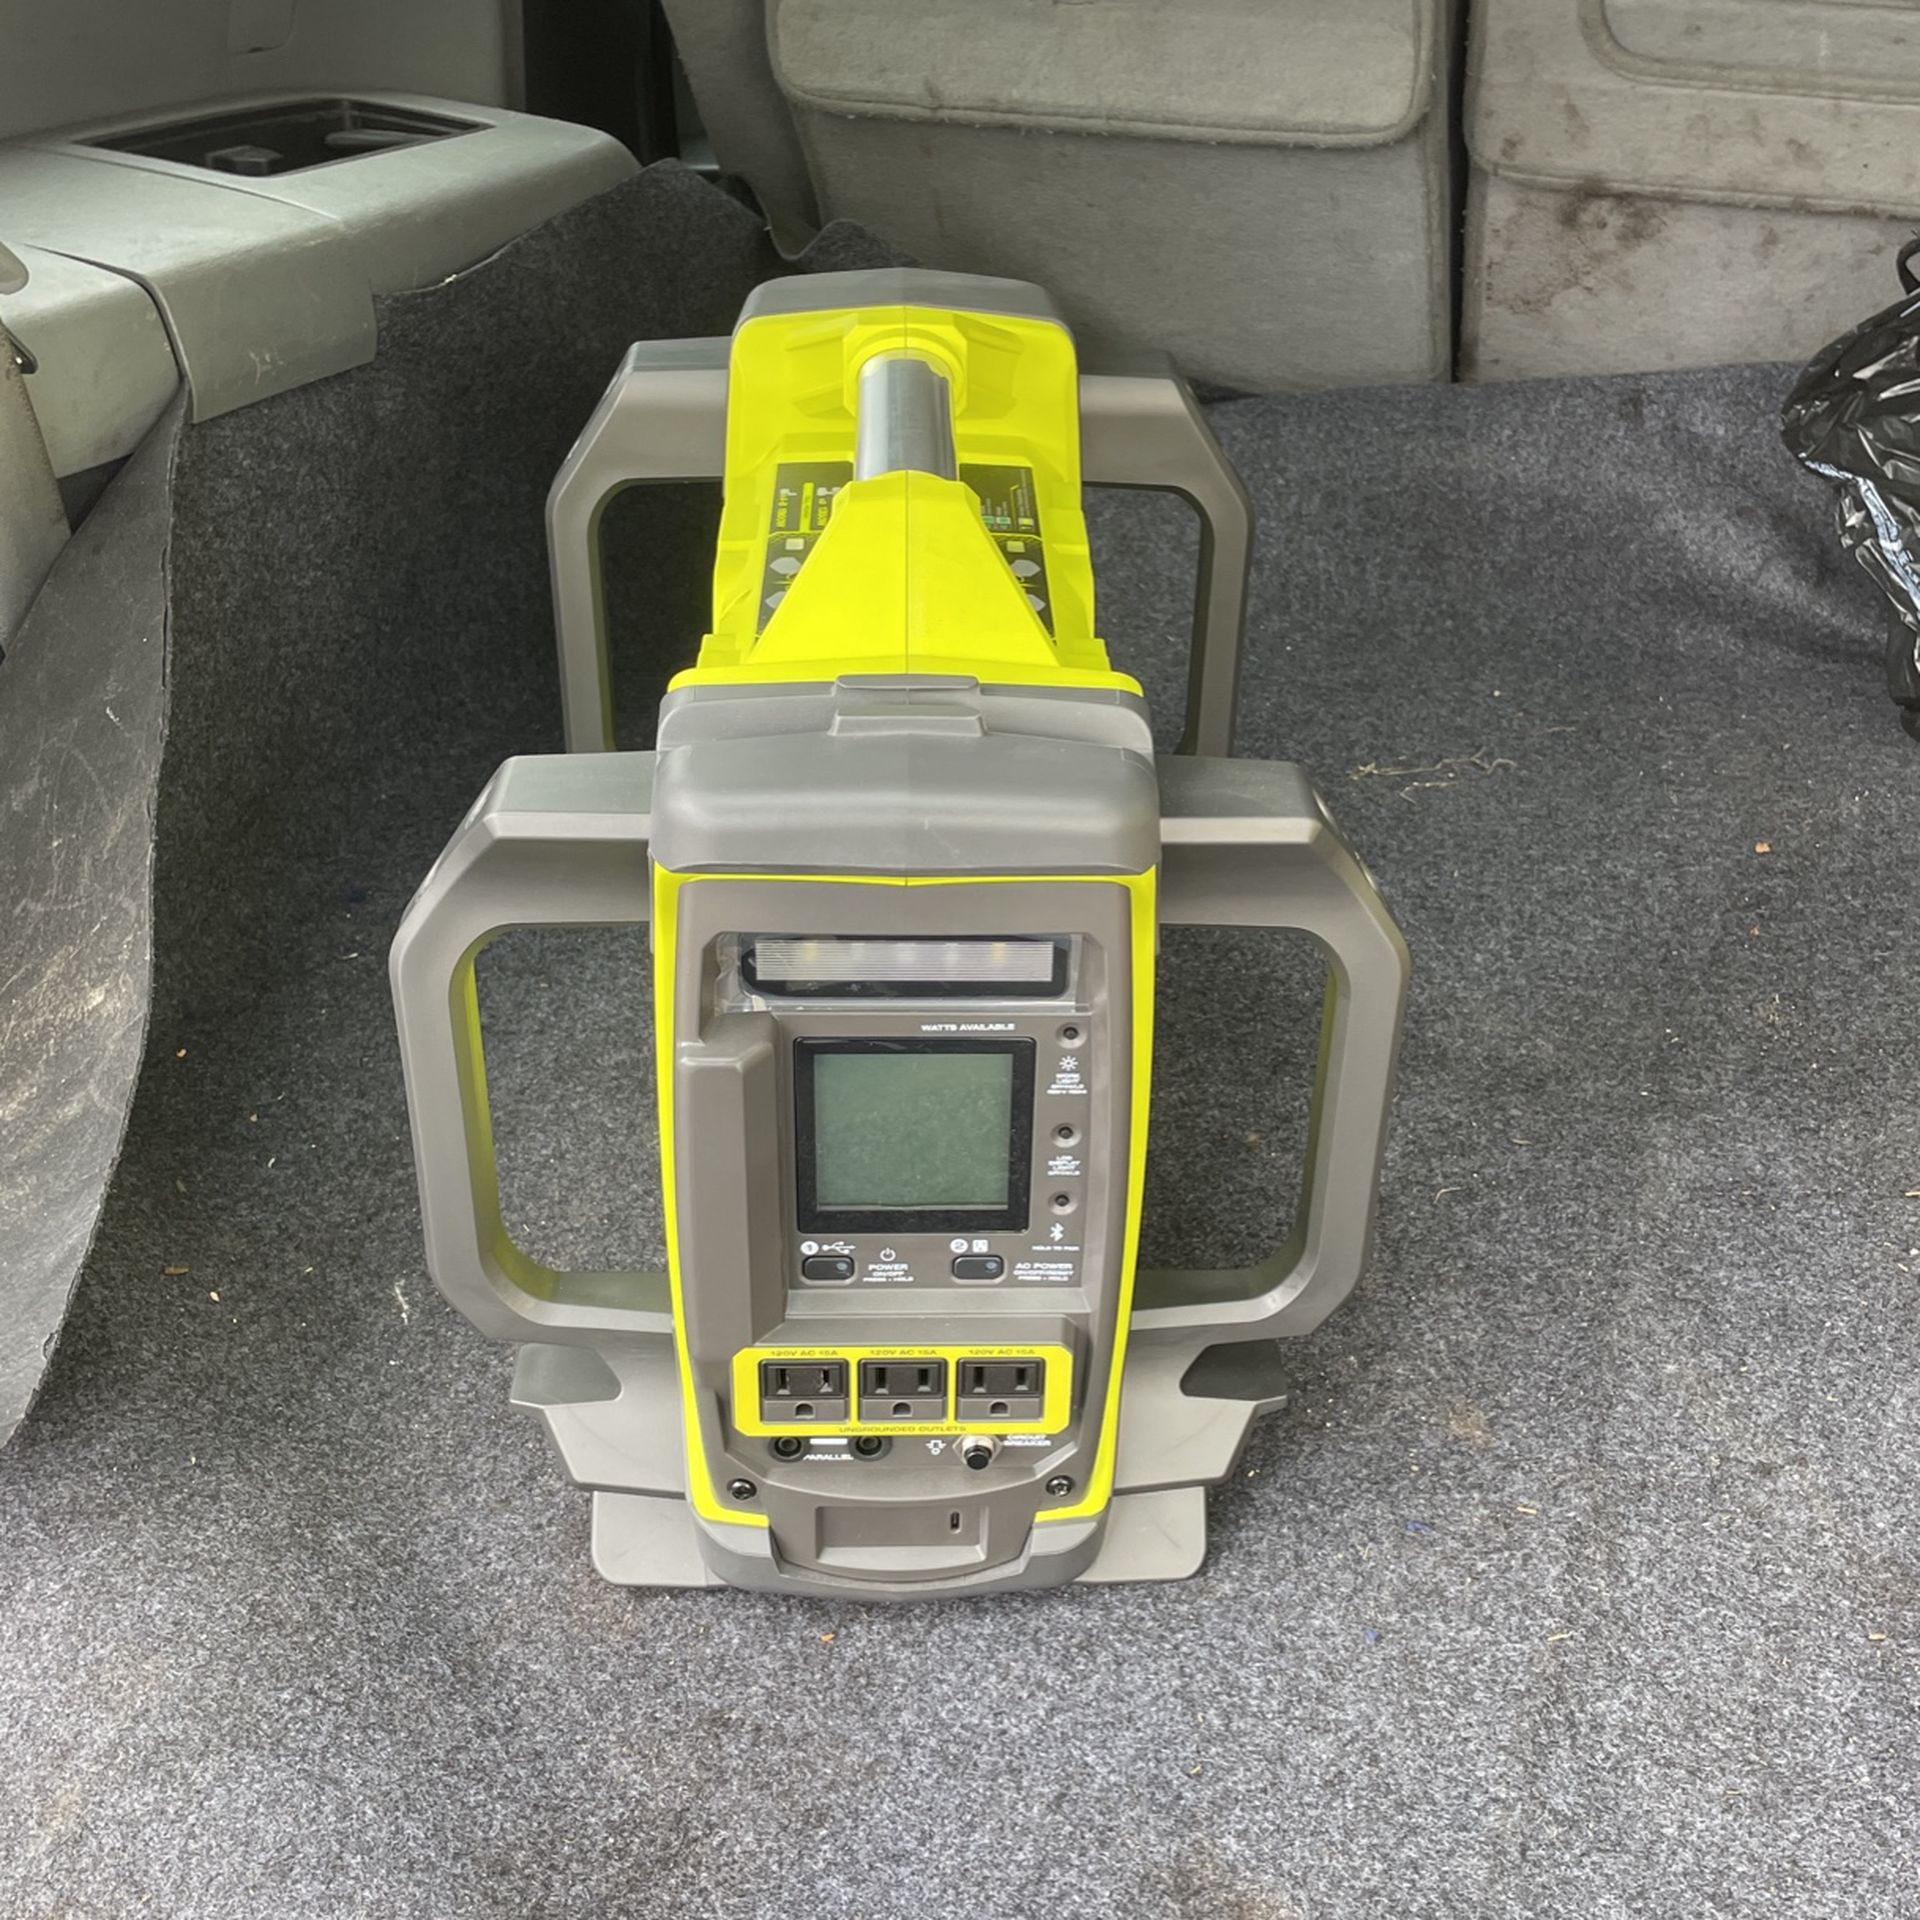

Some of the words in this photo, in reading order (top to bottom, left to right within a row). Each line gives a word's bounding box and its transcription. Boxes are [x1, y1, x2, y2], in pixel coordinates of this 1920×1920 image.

[921, 1023, 957, 1031] WATTS
[959, 1023, 1015, 1031] AVAILABLE
[868, 1263, 908, 1271] POWER
